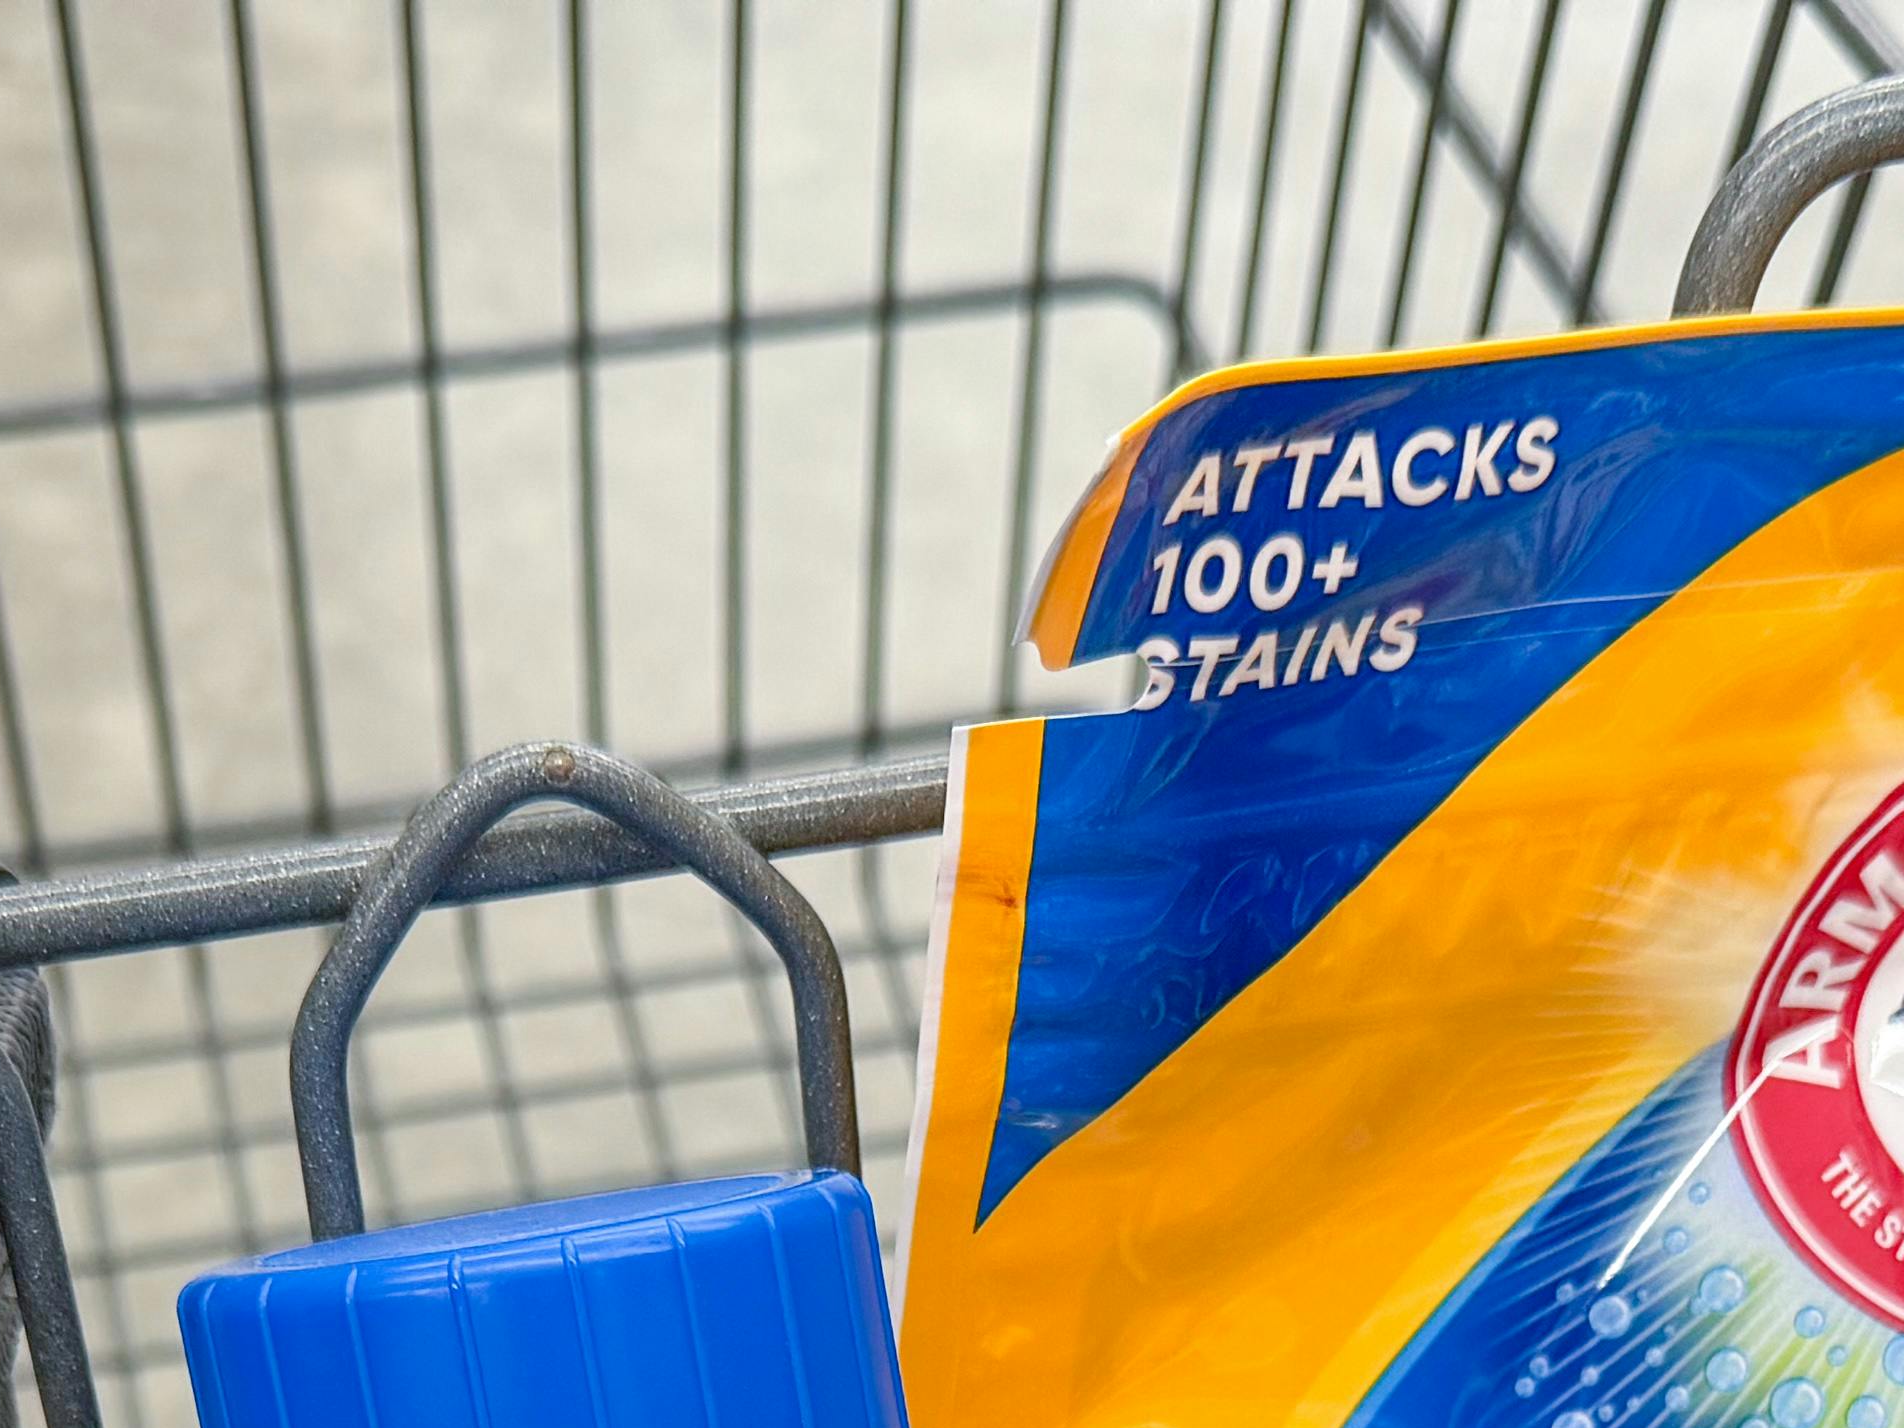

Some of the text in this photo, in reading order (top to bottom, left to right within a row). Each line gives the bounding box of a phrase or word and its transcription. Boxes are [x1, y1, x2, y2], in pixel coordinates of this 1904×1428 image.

[1162, 415, 1559, 527] ATTACKS
[1151, 532, 1358, 615] 100+
[1133, 604, 1425, 711] STAINS
[1819, 1150, 1876, 1228] THE
